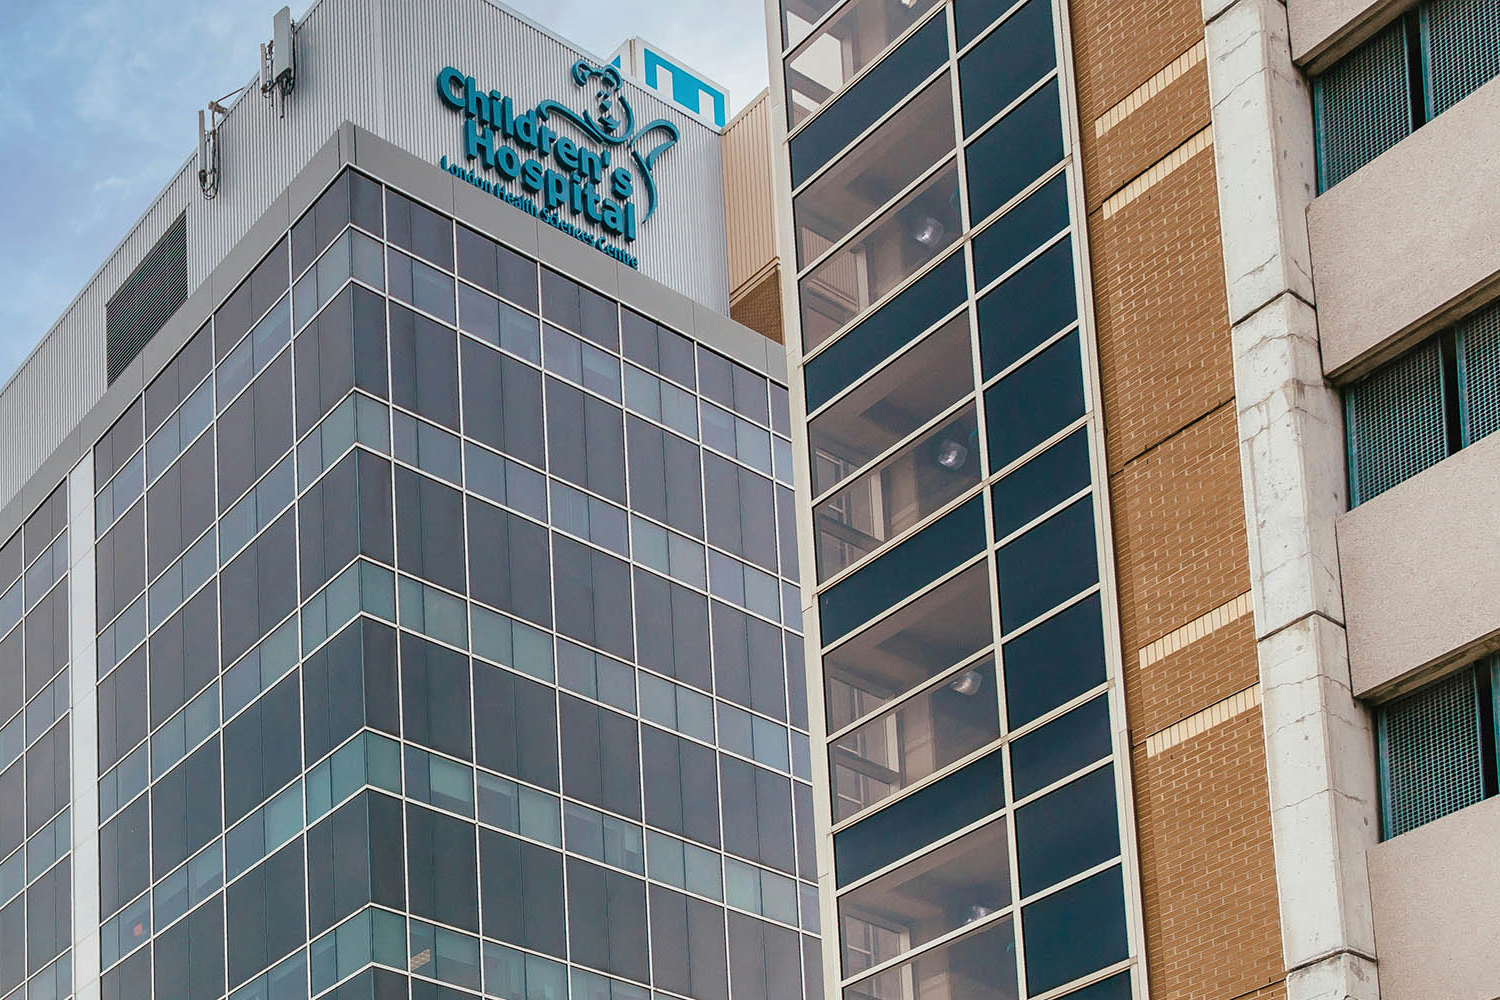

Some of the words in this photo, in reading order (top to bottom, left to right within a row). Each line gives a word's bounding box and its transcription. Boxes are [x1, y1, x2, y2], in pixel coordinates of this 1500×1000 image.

[436, 66, 634, 199] Children's
[464, 118, 636, 243] Hospital
[440, 155, 492, 194] London
[493, 183, 538, 217] Health
[539, 207, 595, 247] Sciences
[595, 237, 639, 269] Centre
